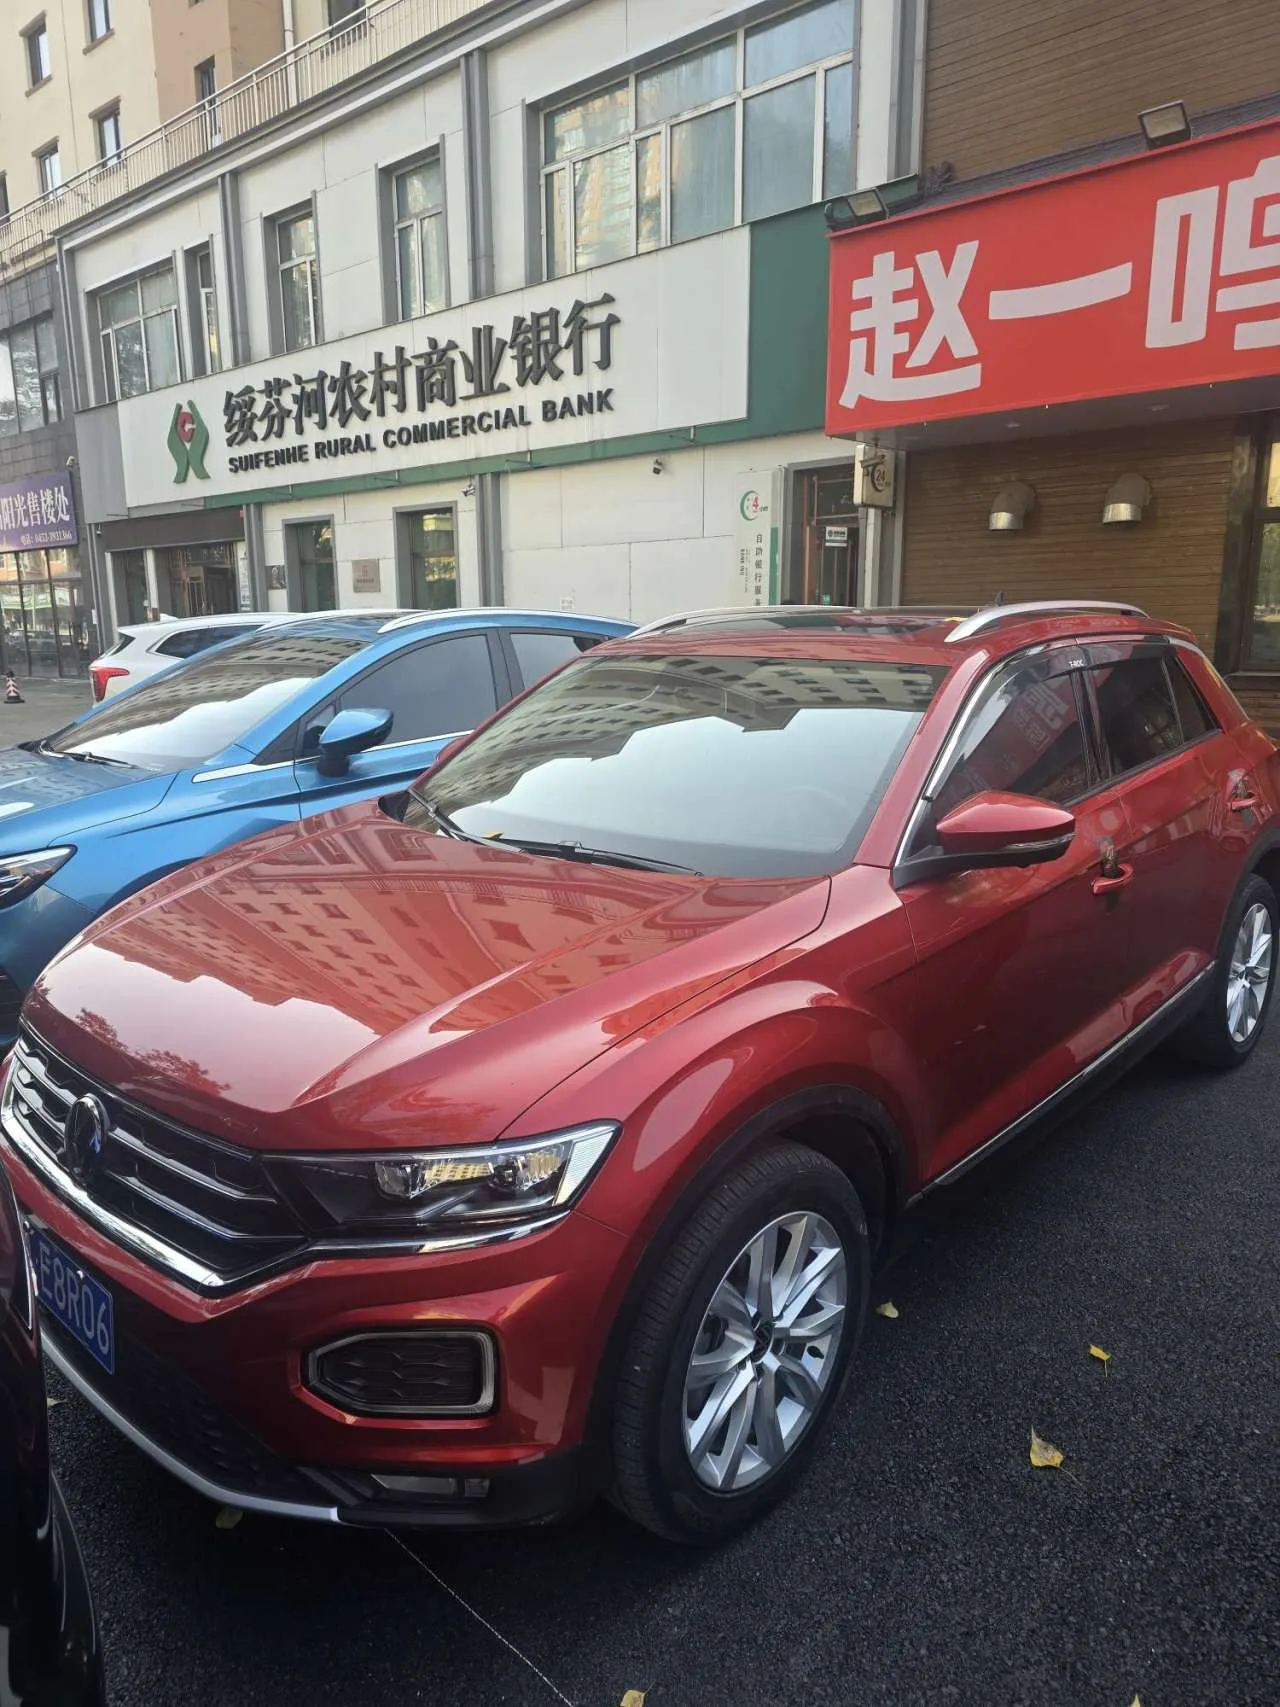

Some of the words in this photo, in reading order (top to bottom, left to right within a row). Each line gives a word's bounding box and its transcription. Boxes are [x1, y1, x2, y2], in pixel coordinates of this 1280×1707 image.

[223, 292, 621, 448] 绥芬河农村商业银行
[228, 444, 309, 474] SUIFENHE
[314, 433, 377, 460] RURAL
[382, 404, 531, 449] COMMERCIAL
[541, 388, 614, 423] BANK
[0, 485, 70, 531] 阳光售楼处
[875, 469, 886, 482] 24
[39, 1244, 109, 1355] E8R06
